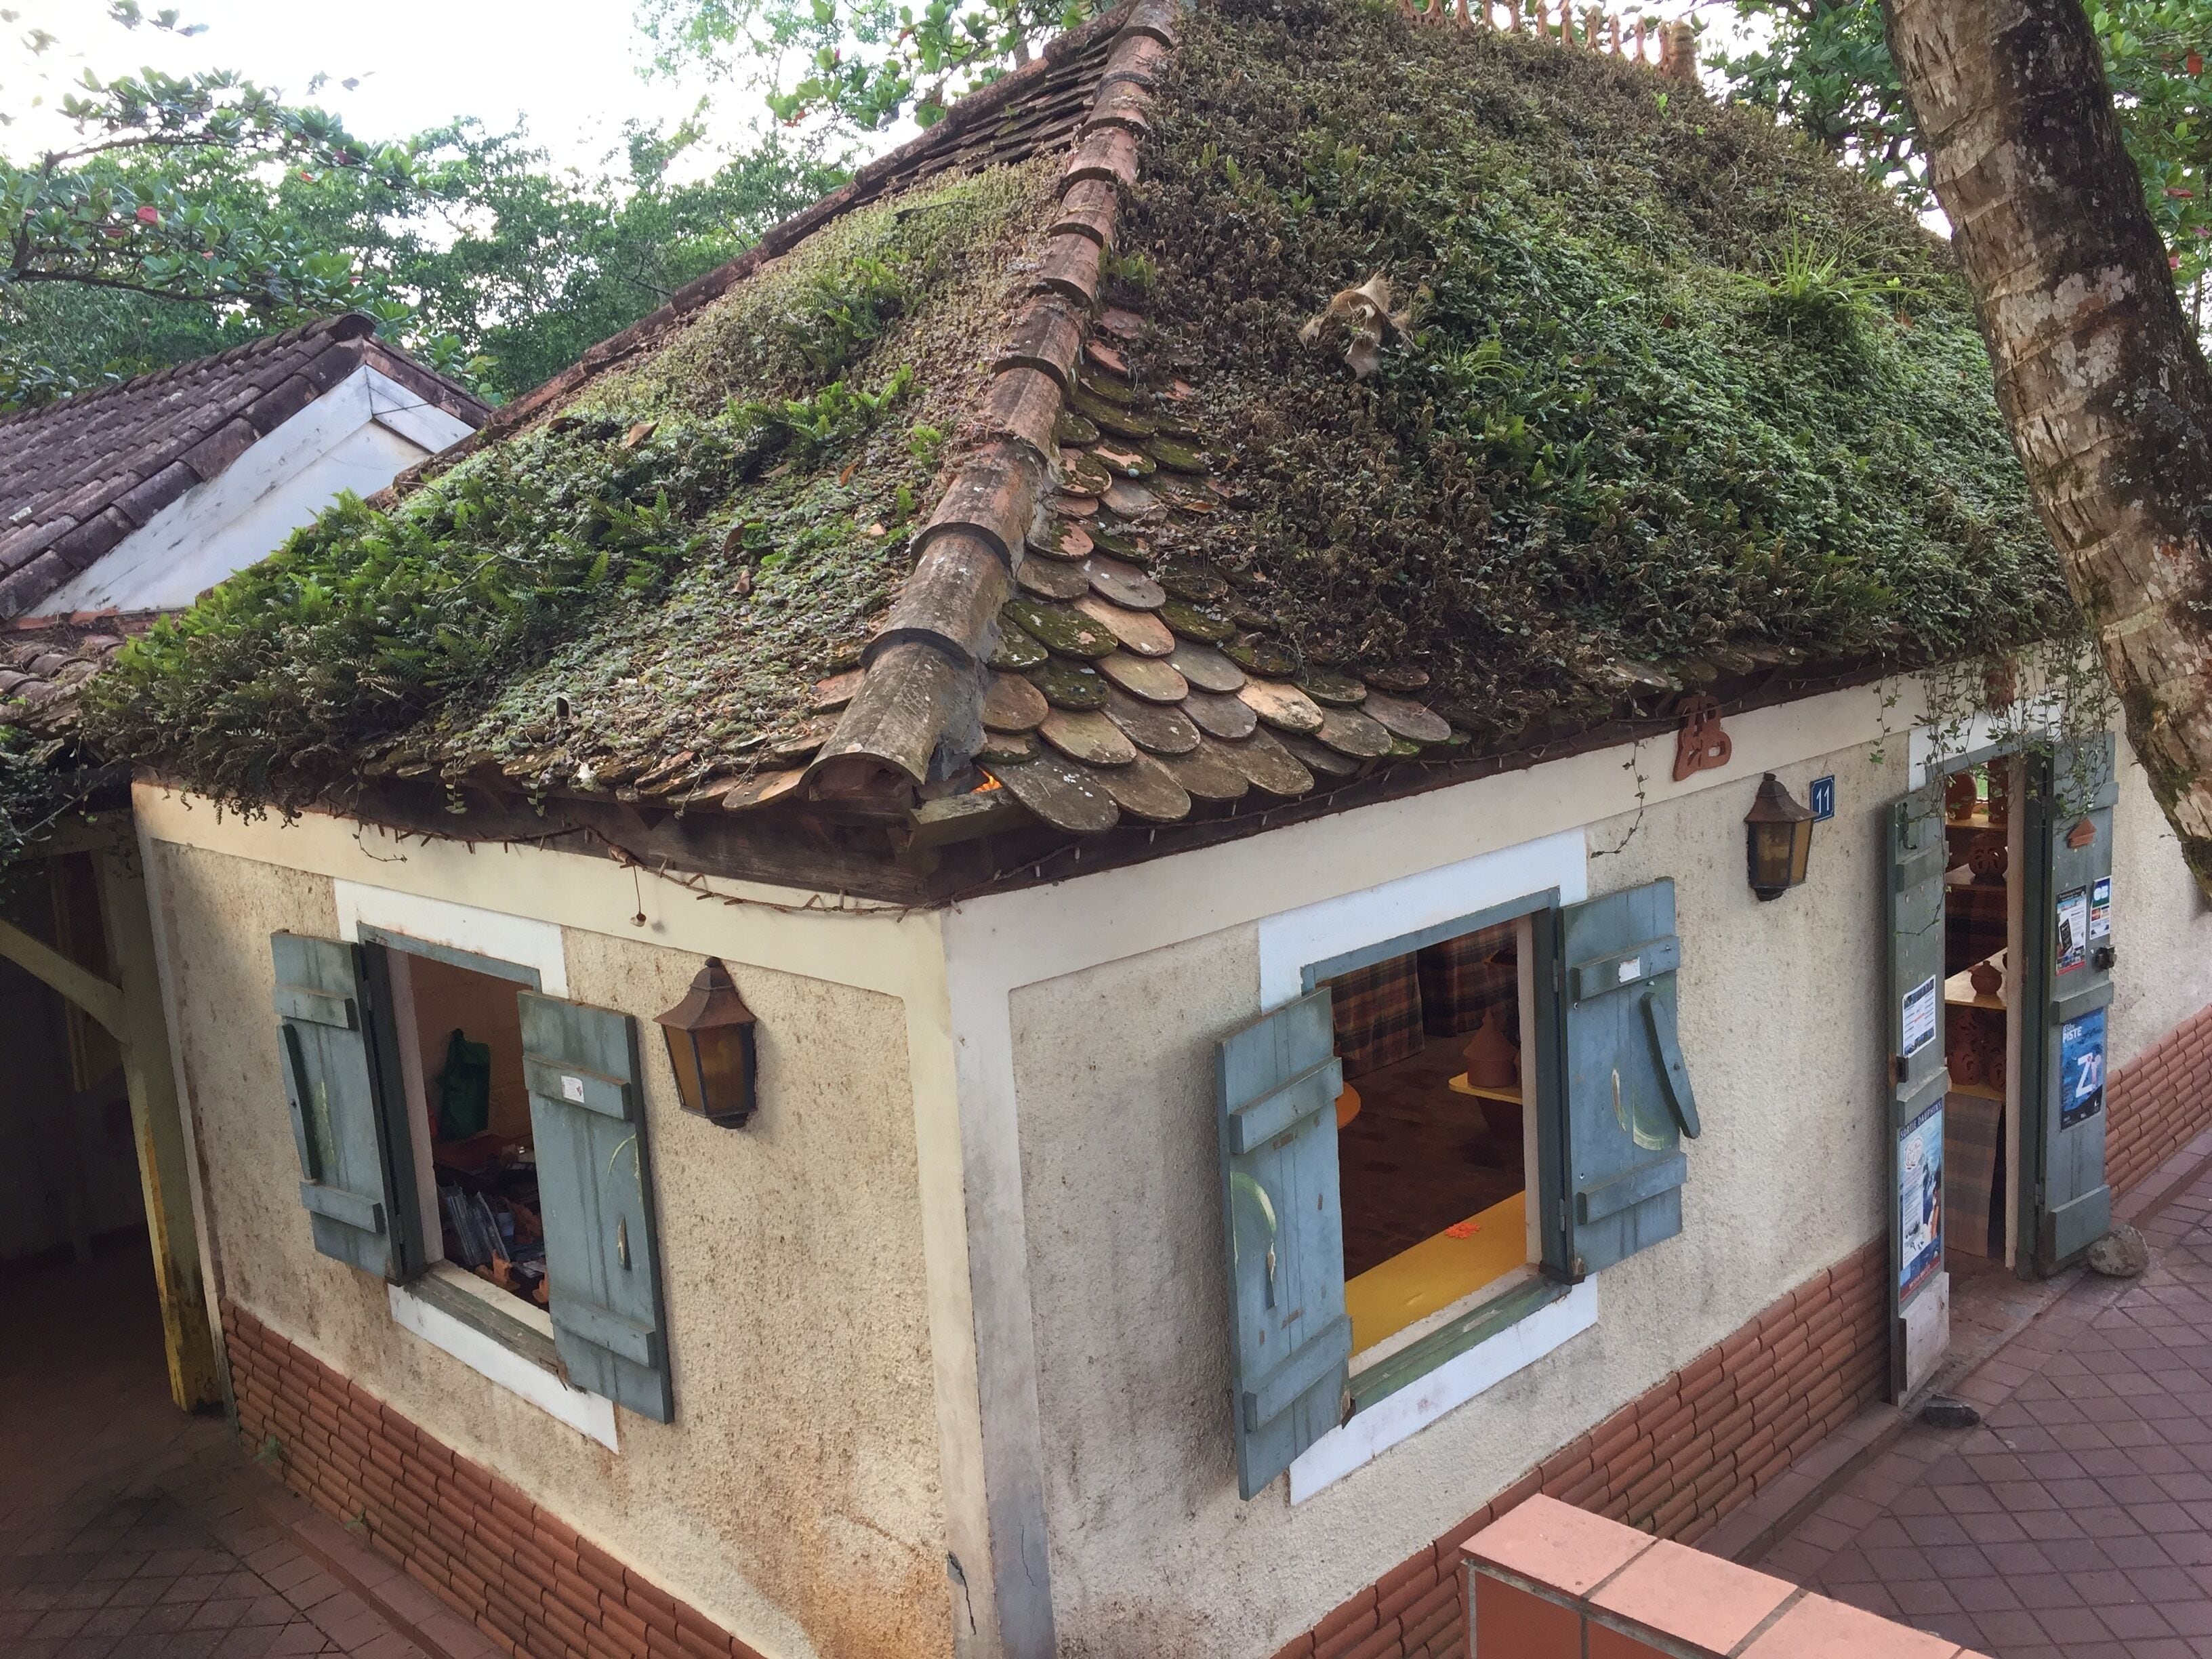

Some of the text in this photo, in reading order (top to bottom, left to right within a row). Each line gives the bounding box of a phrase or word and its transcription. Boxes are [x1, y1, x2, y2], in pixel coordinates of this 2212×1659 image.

[1816, 785, 1830, 814] 11
[2062, 1026, 2083, 1044] PISTE
[1900, 1100, 1942, 1140] SORTIE DAUPHINS
